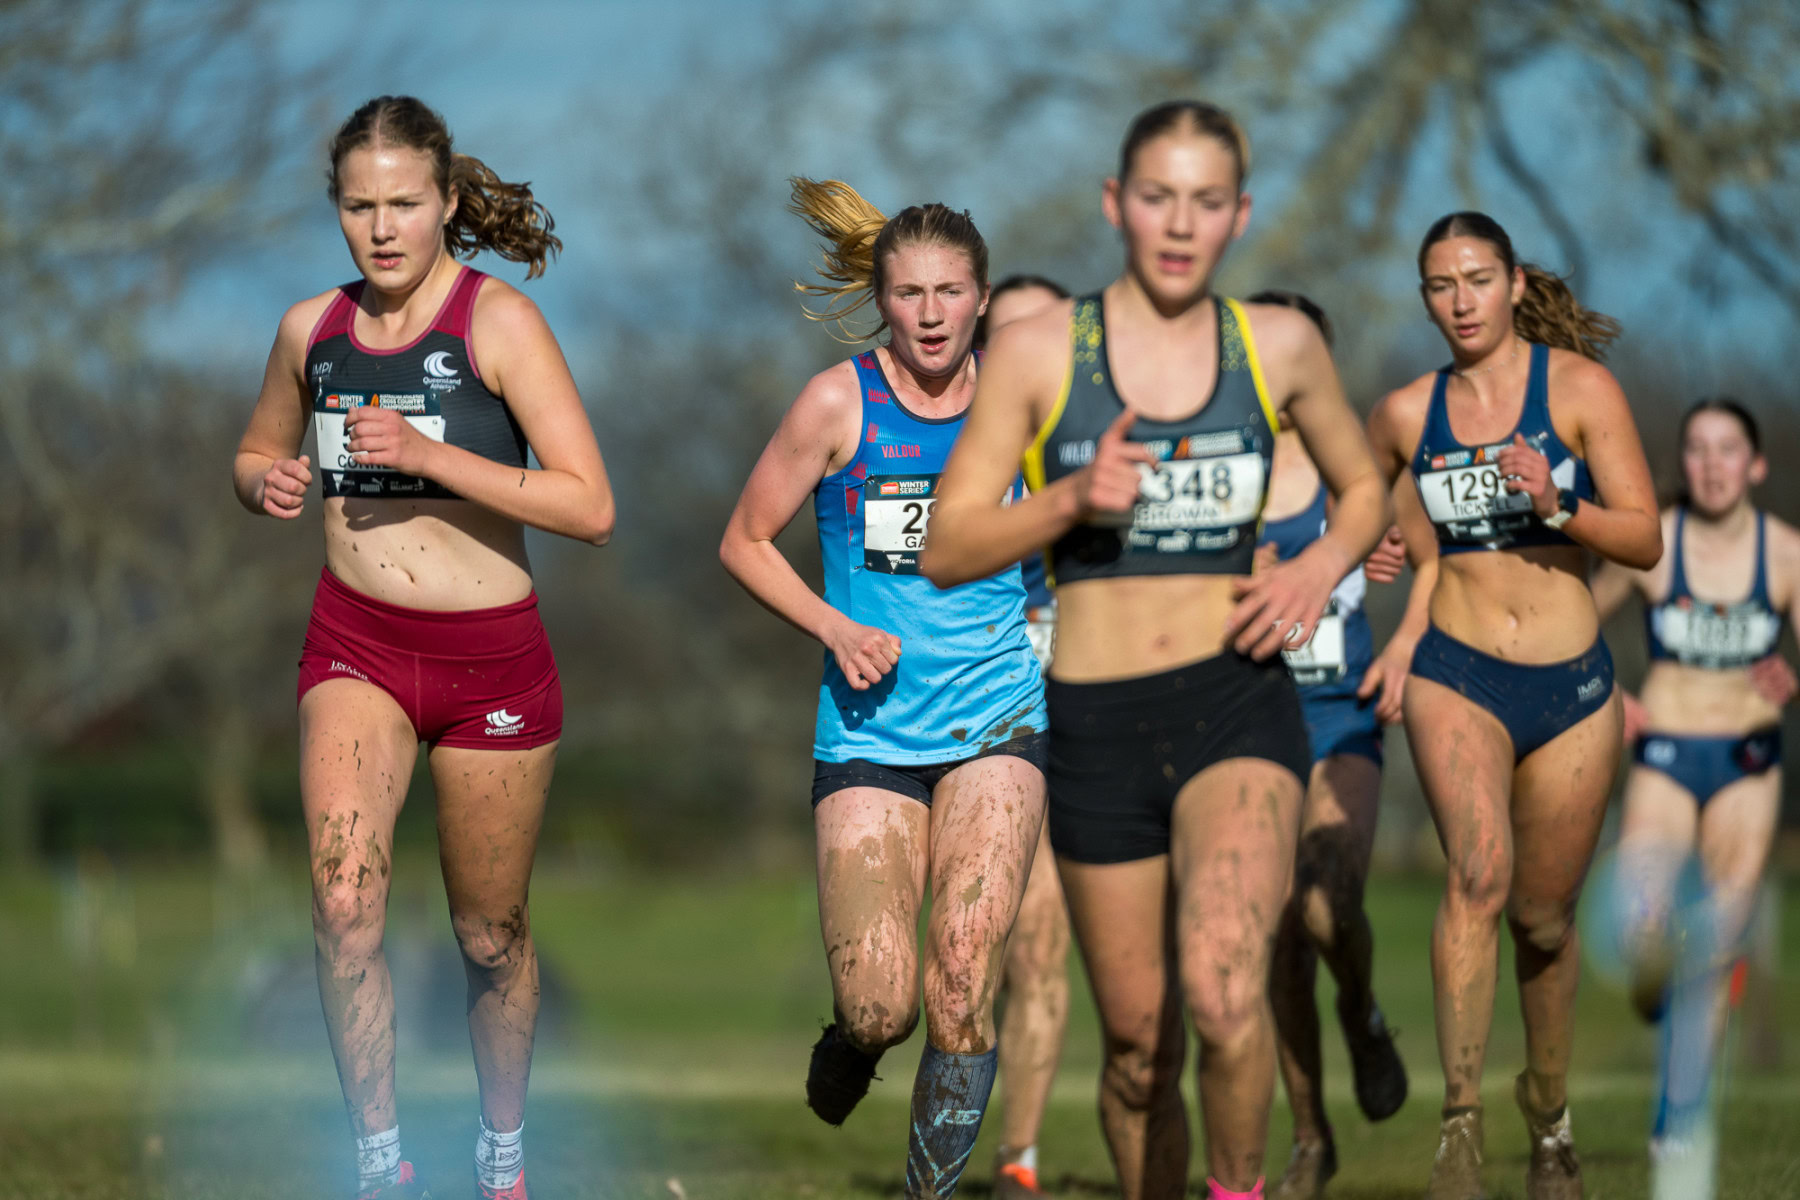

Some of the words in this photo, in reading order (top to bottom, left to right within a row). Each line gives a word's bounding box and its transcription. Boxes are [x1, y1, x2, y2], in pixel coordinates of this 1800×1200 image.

[422, 376, 462, 386] Queensland
[339, 394, 364, 402] WINTER
[881, 444, 921, 458] VALOUR
[1156, 464, 1233, 502] 348
[484, 721, 525, 735] Queensland
